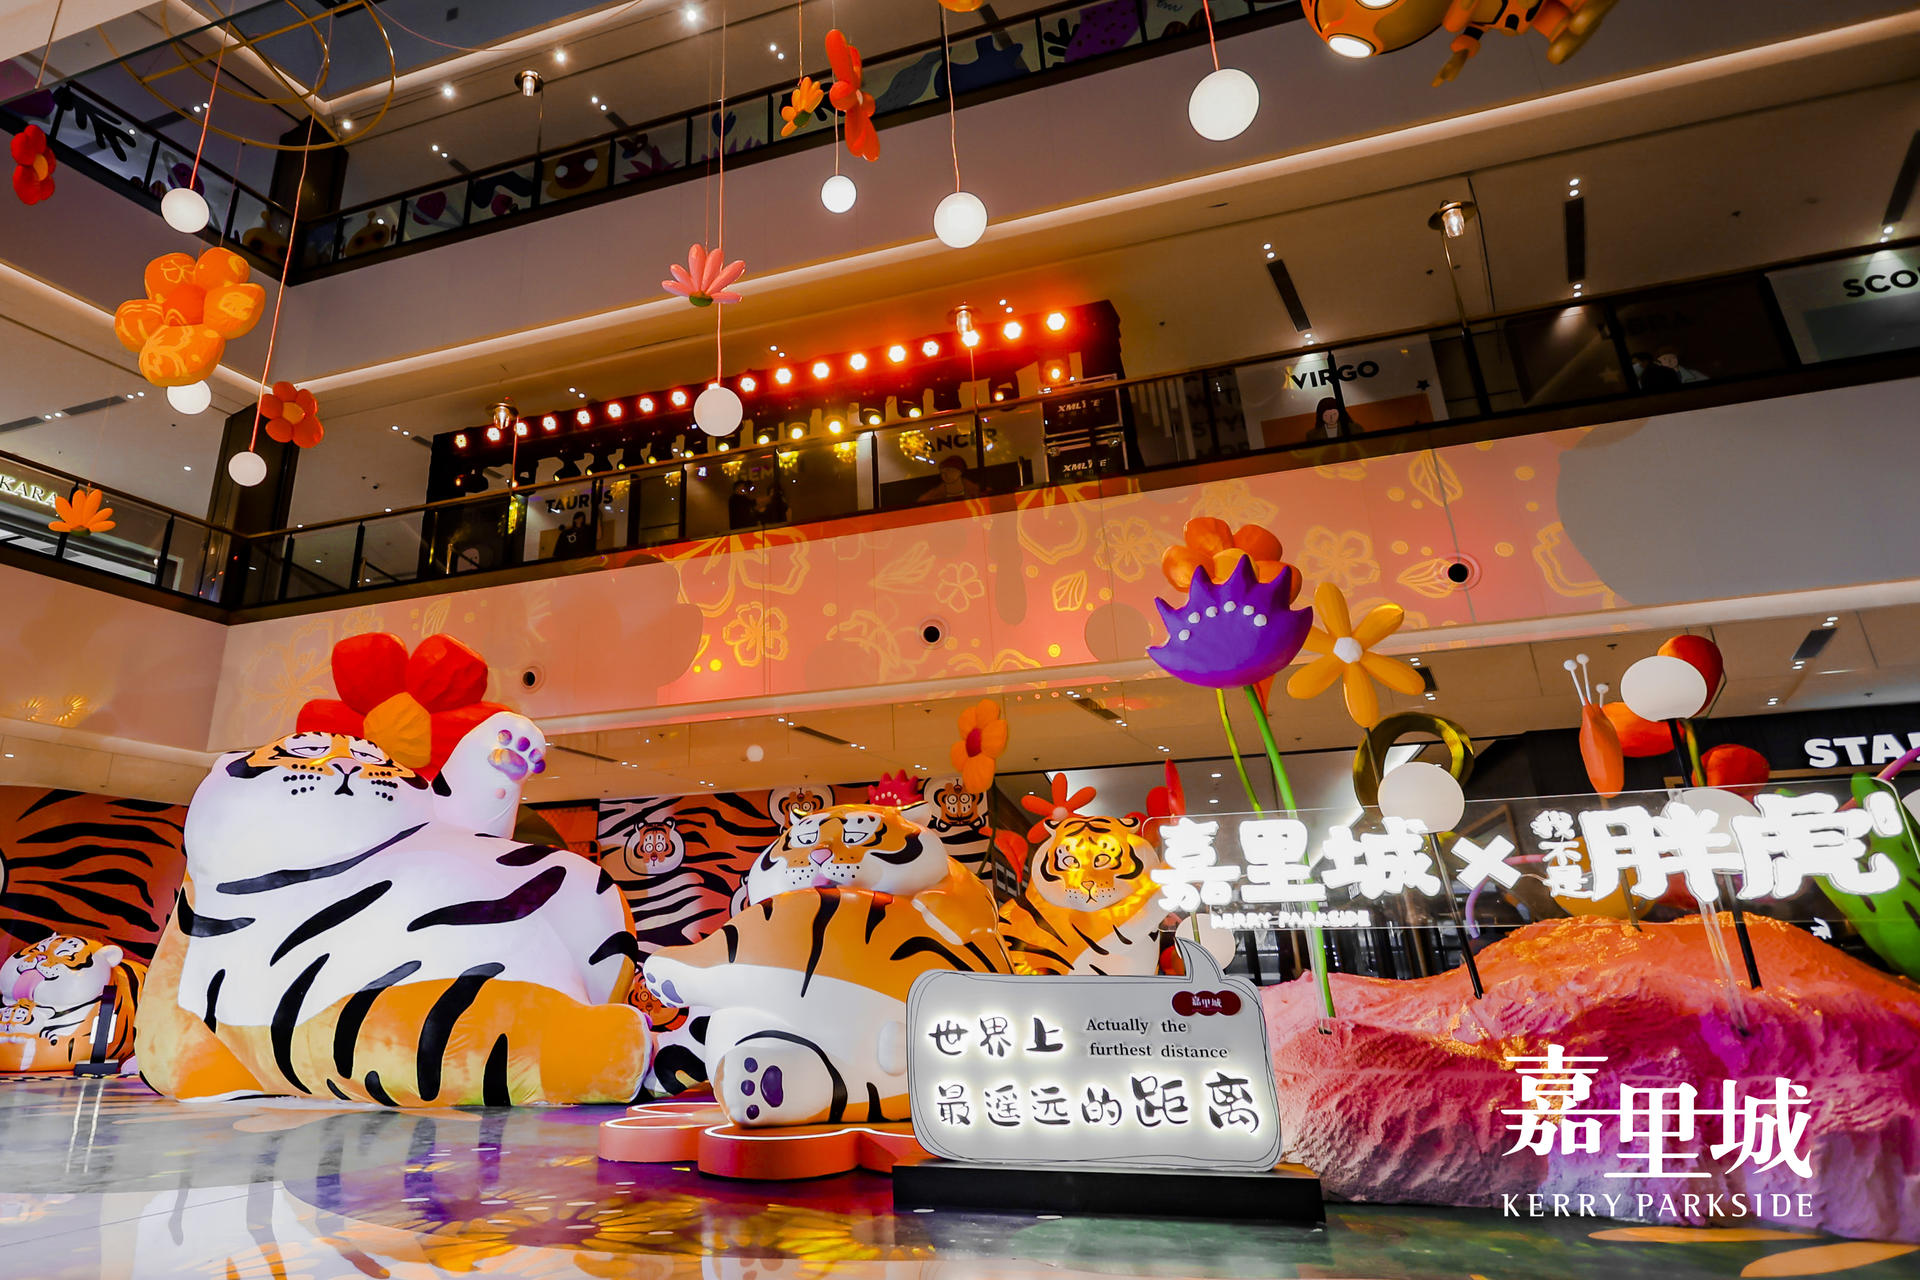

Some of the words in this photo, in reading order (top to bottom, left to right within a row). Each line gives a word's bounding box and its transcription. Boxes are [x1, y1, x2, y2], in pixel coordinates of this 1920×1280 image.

[1843, 267, 1920, 297] SCO
[1290, 361, 1379, 389] VIRGO
[1150, 816, 1441, 912] 嘉里城
[1579, 791, 1904, 902] 胖虎
[1278, 909, 1371, 928] PARKSIDE
[928, 1016, 1063, 1056] 世界上
[1086, 1019, 1149, 1034] Actually
[1161, 1020, 1187, 1033] the
[1090, 1043, 1152, 1057] furthest
[1161, 1045, 1229, 1058] distance
[937, 1071, 1260, 1133] 最遥远的距离
